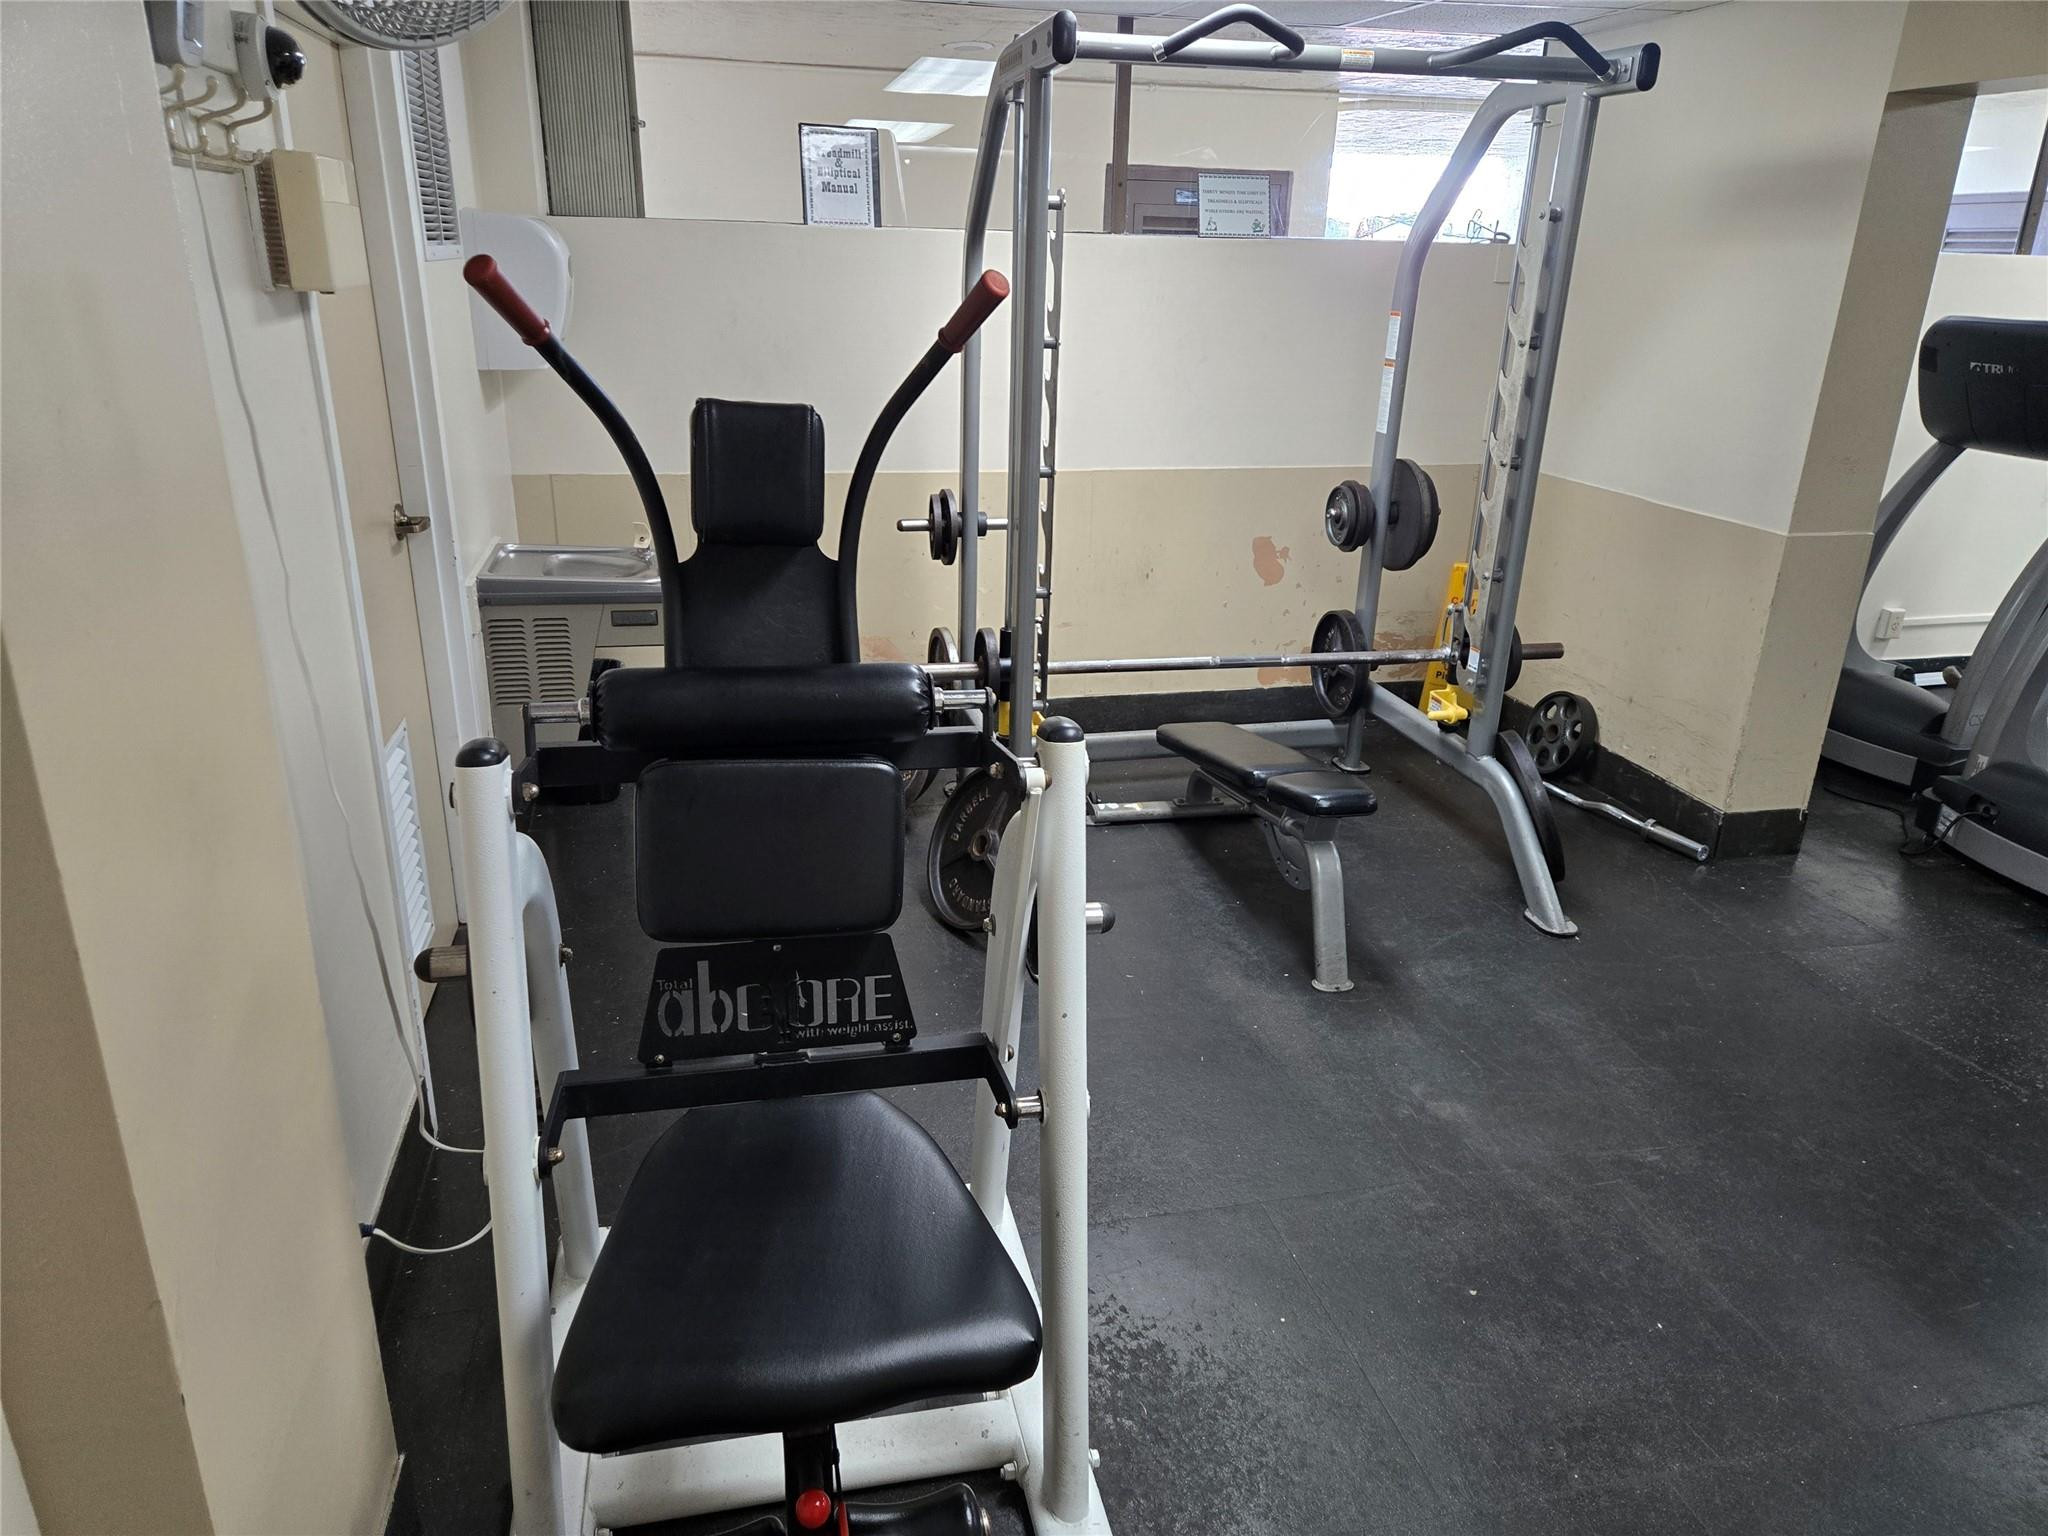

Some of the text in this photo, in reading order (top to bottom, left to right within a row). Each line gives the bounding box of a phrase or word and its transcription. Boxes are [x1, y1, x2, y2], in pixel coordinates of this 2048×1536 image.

[834, 158, 843, 168] &
[821, 182, 858, 194] Manual
[655, 977, 694, 991] Total
[794, 1028, 823, 1040] with
[826, 1023, 871, 1039] weight
